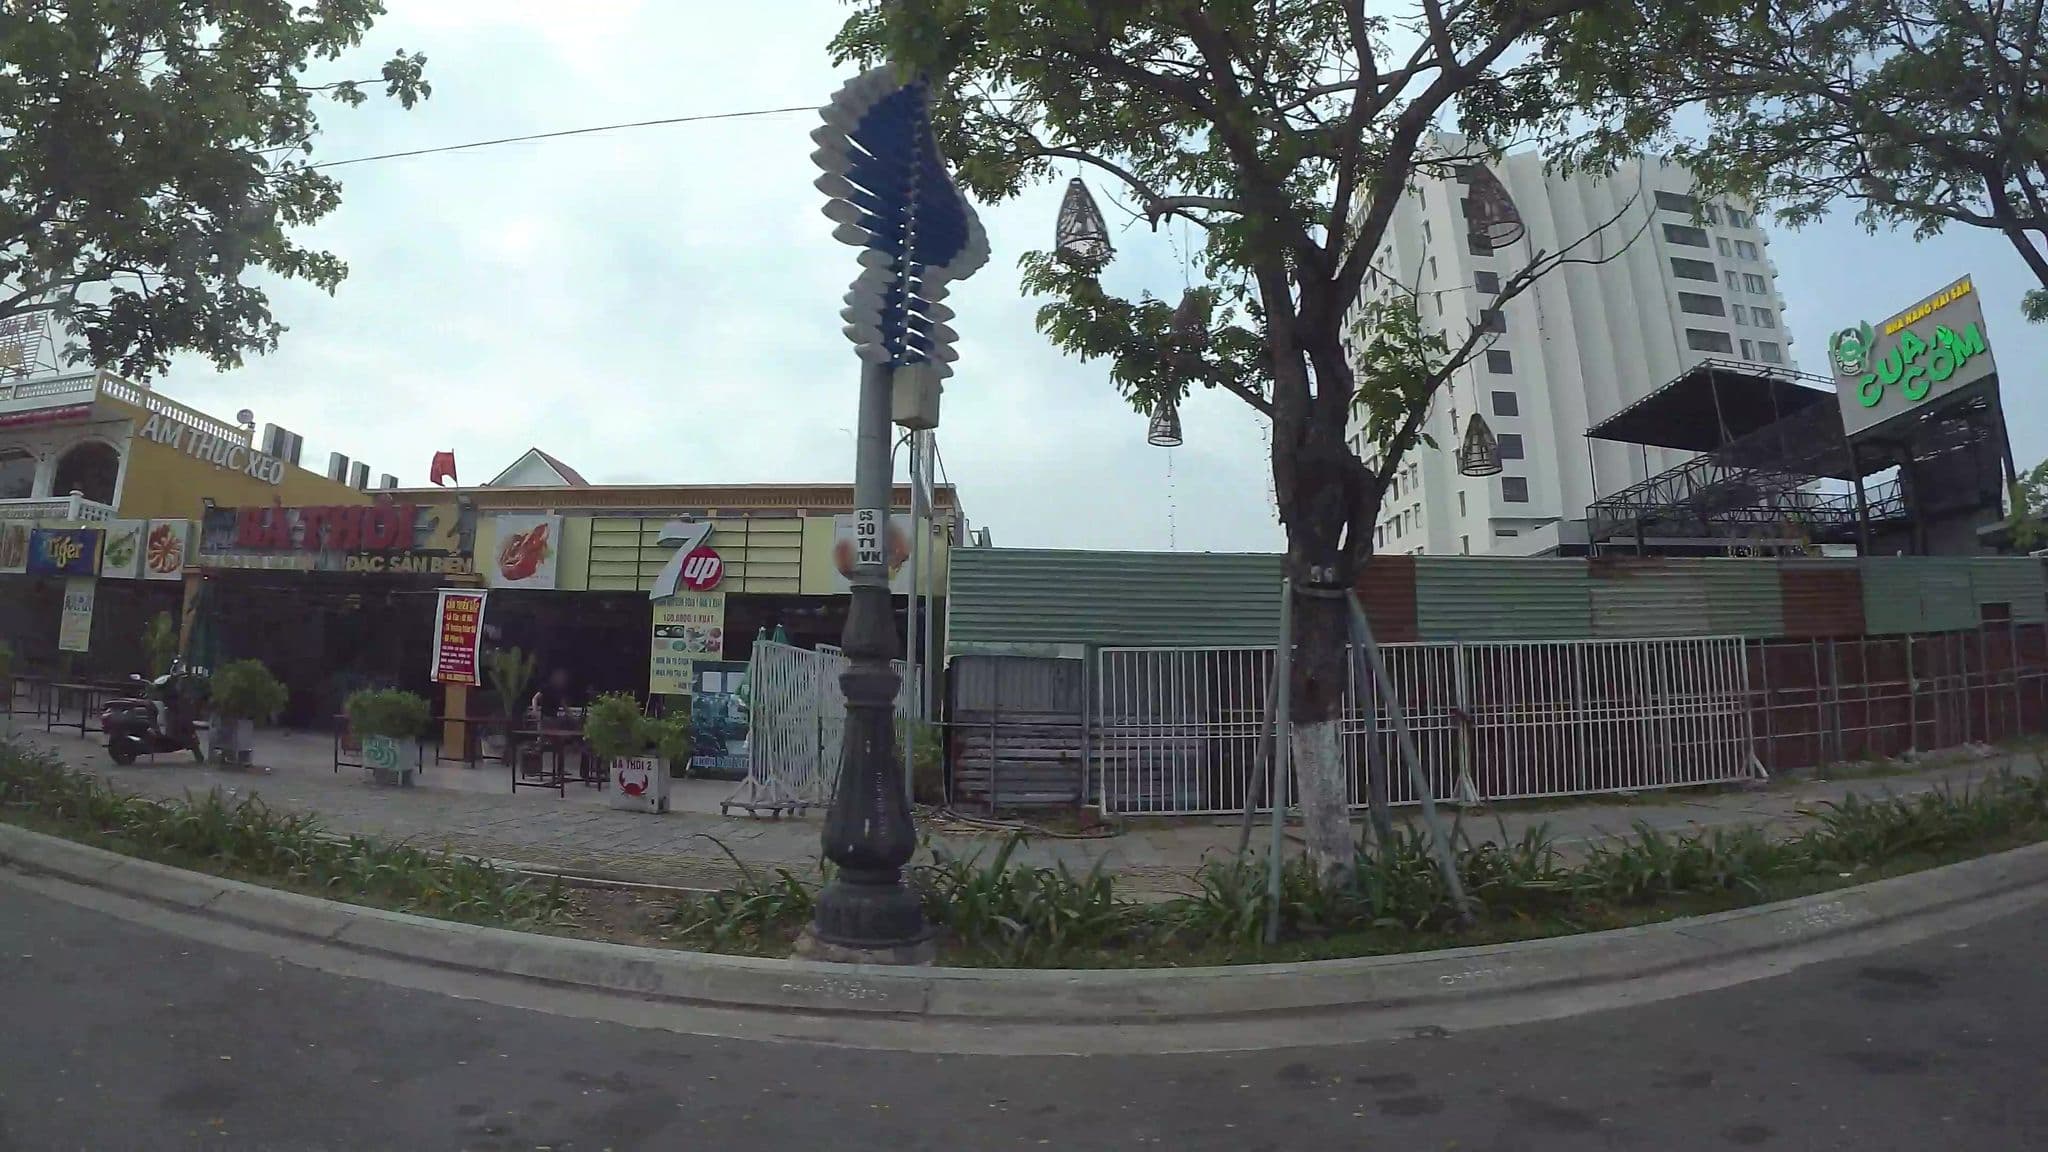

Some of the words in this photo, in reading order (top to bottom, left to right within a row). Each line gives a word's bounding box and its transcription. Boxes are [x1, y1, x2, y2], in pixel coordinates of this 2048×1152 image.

[1856, 329, 1928, 408] CUA
[859, 510, 873, 521] CS
[857, 522, 876, 536] 50
